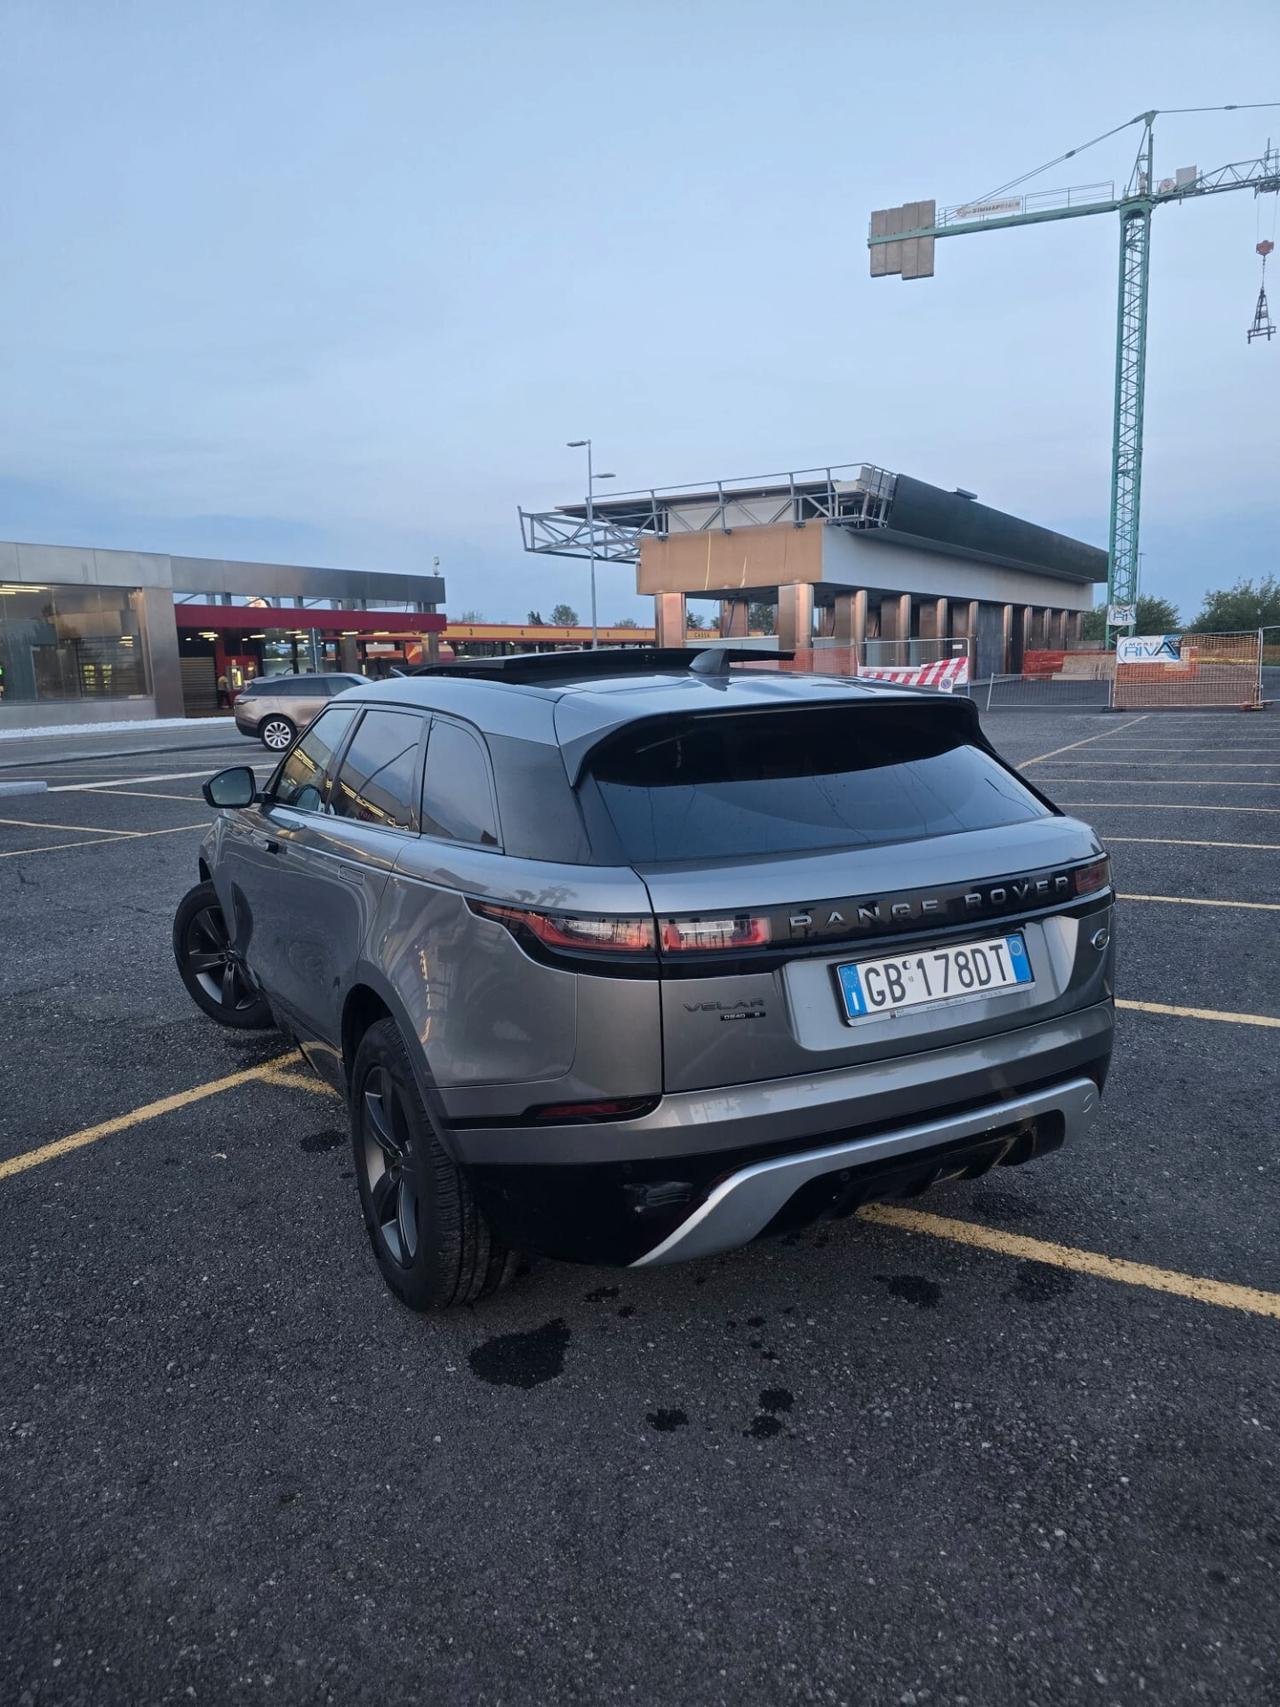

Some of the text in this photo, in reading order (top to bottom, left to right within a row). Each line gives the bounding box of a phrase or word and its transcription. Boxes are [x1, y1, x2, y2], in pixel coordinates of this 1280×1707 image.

[1124, 641, 1177, 657] RIVA
[789, 876, 1069, 935] RANGE ROVER
[682, 998, 765, 1012] VELAR
